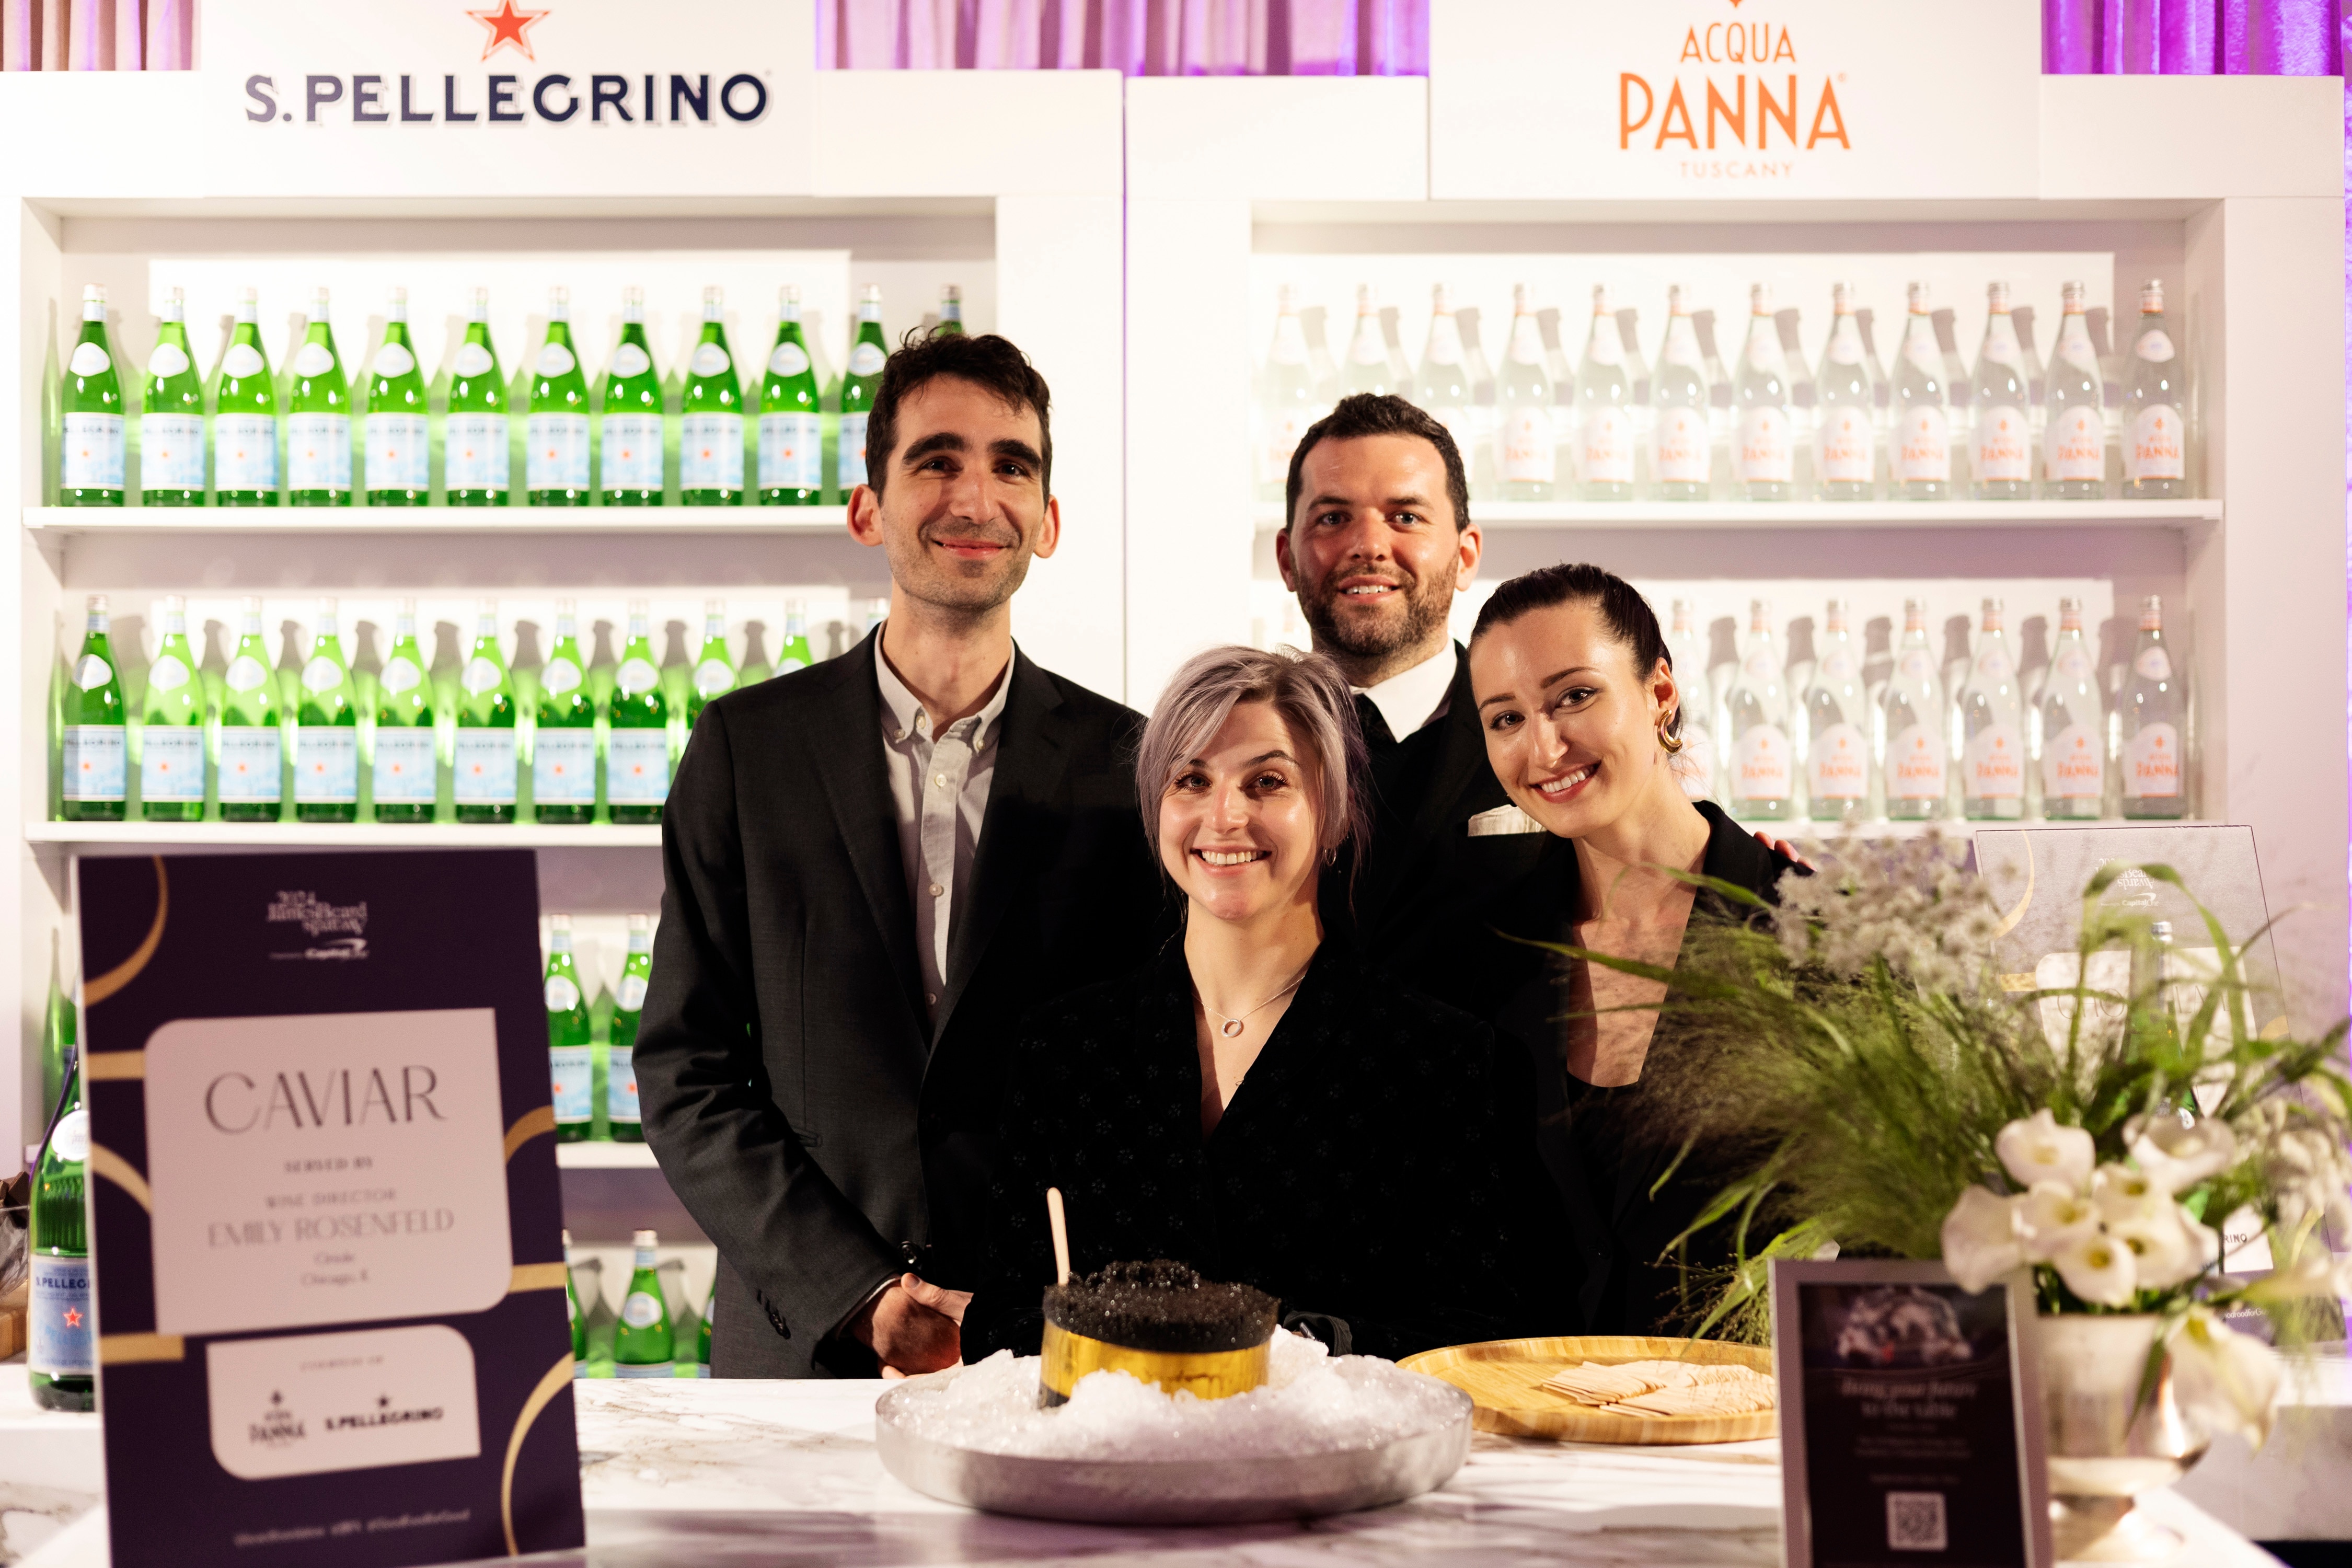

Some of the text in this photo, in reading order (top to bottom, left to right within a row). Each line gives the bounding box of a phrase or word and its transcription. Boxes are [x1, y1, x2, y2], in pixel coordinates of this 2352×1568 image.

[1680, 23, 1796, 63] ACQUA
[245, 74, 768, 124] S.PELLEGRINO
[1619, 72, 1851, 150] PANNA
[1680, 162, 1794, 178] TUSCANY
[205, 1064, 447, 1135] CAVIAR
[209, 1207, 455, 1248] EMILY ROSENFELD
